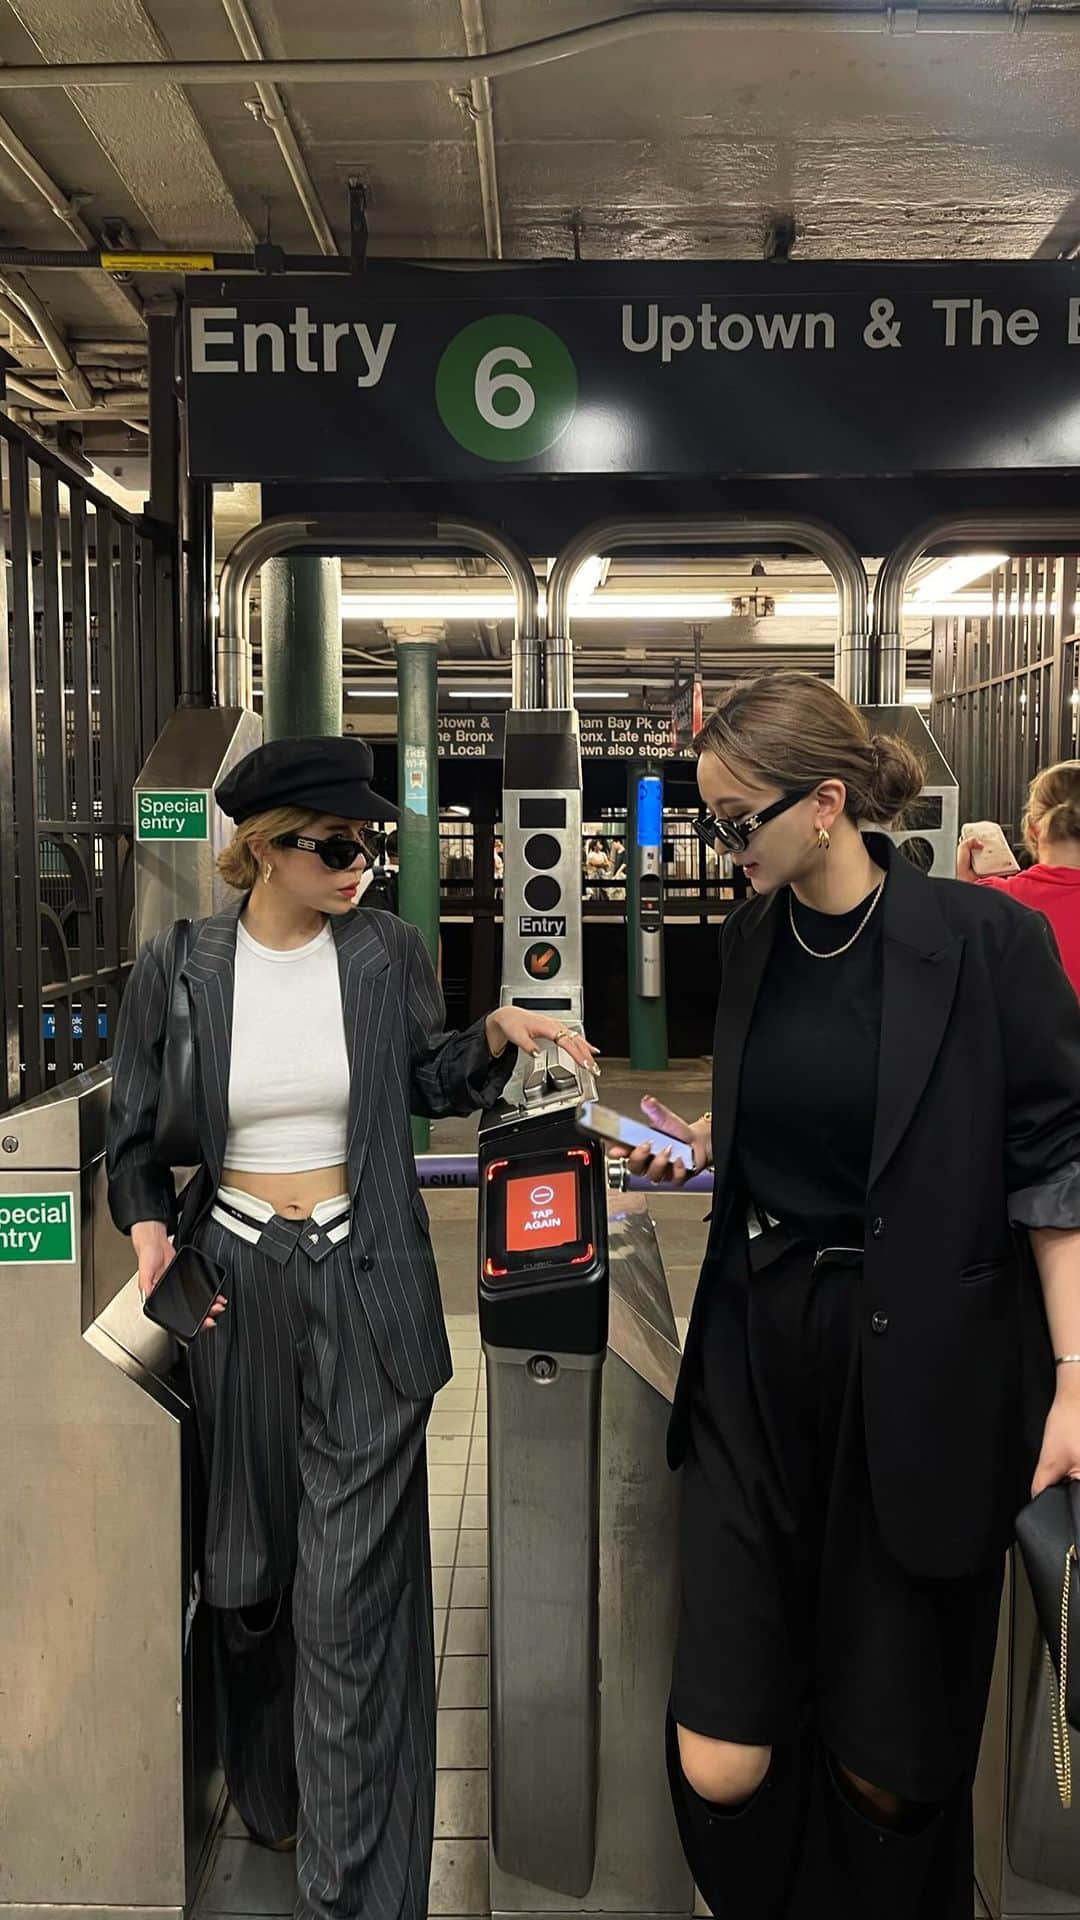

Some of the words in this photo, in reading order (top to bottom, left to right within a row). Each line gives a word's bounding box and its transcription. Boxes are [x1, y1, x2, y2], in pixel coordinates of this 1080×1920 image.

[622, 303, 836, 363] Uptown
[863, 298, 902, 349] &
[932, 299, 1040, 346] The
[190, 307, 397, 388] Entry
[474, 345, 536, 430] 6
[480, 716, 490, 729] &
[607, 717, 631, 730] Bay
[636, 717, 652, 729] Pk
[657, 720, 671, 730] or
[455, 729, 495, 742] Bronx
[611, 730, 639, 743] Late
[450, 743, 486, 756] Local
[607, 744, 634, 756] also
[639, 745, 675, 759] stops
[141, 798, 204, 817] Special
[141, 815, 186, 833] entry
[521, 917, 565, 936] Entry
[531, 1209, 554, 1220] TAP
[523, 1217, 561, 1232] AGAIN
